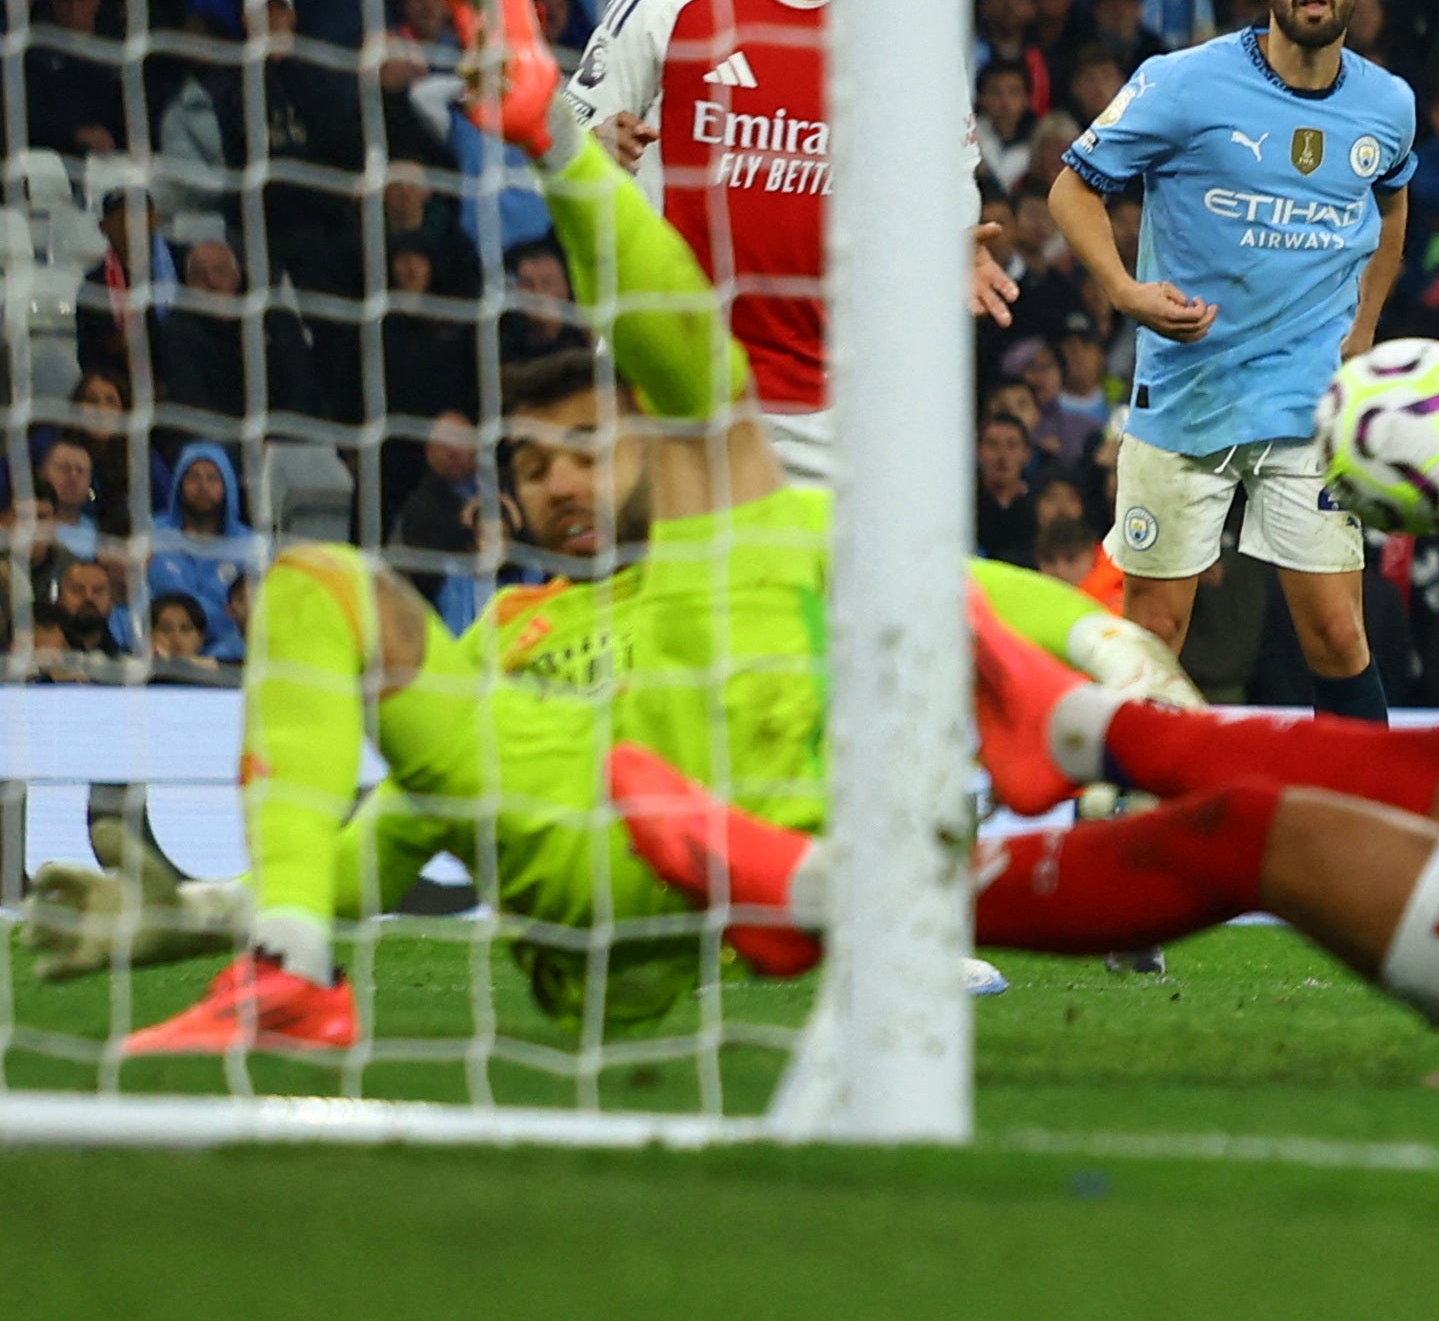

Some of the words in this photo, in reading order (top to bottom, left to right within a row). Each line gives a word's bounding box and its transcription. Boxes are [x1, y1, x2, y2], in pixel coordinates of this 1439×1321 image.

[713, 152, 763, 190] FLY
[1203, 186, 1365, 228] ETIHAD
[1239, 228, 1346, 251] AIRWAYS
